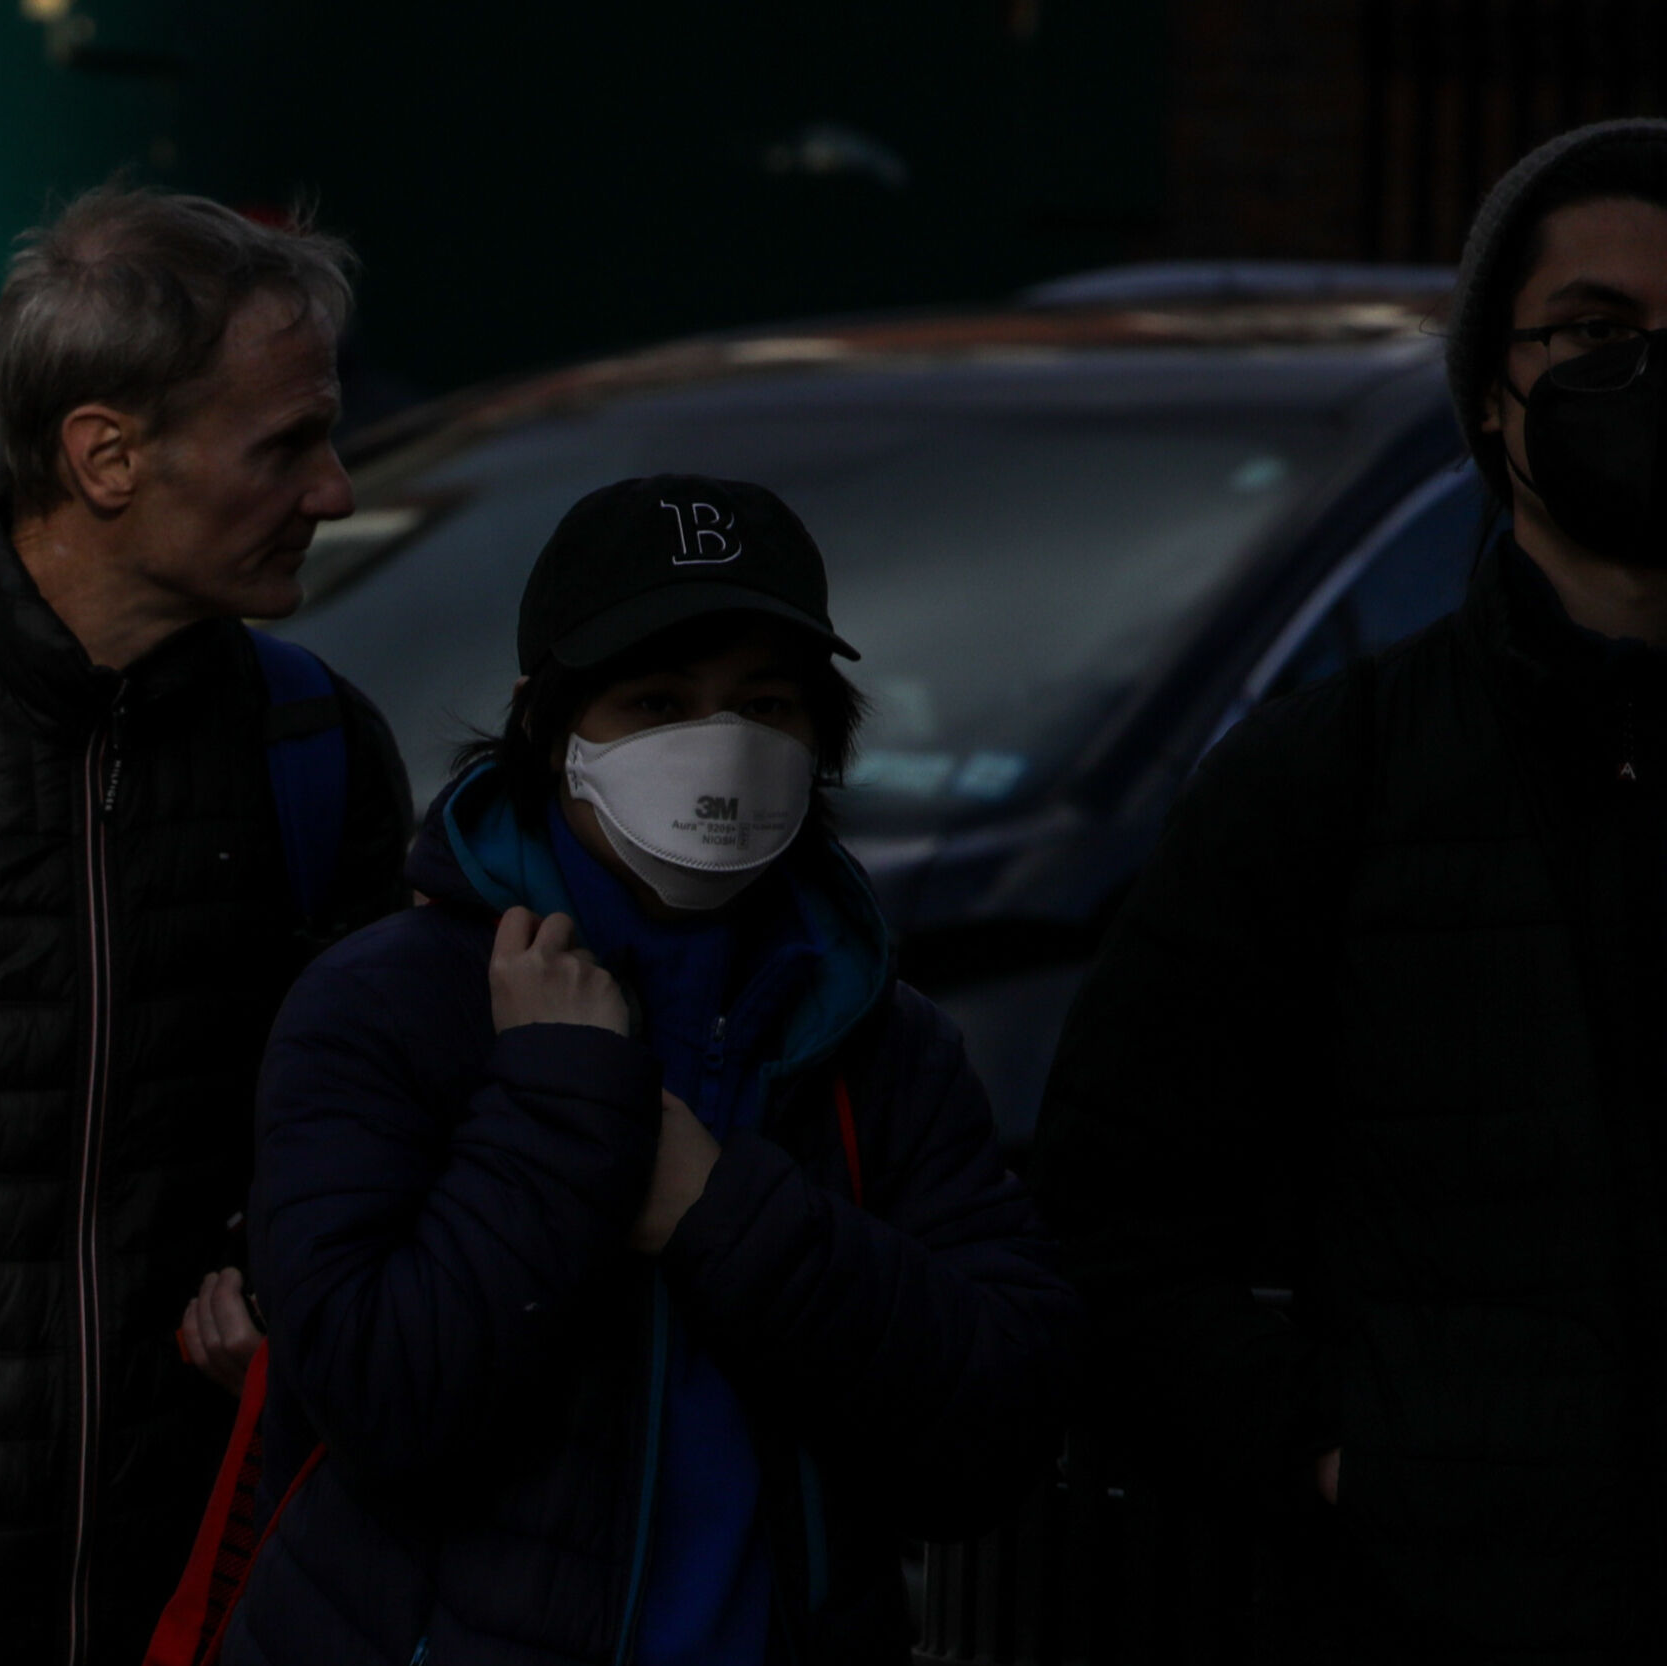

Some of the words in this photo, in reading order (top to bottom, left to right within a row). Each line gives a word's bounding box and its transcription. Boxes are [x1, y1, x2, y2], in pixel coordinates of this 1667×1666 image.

[660, 500, 742, 565] B
[104, 760, 122, 812] HILFIGER
[695, 795, 739, 821] 3M
[702, 834, 736, 847] NIOSH
